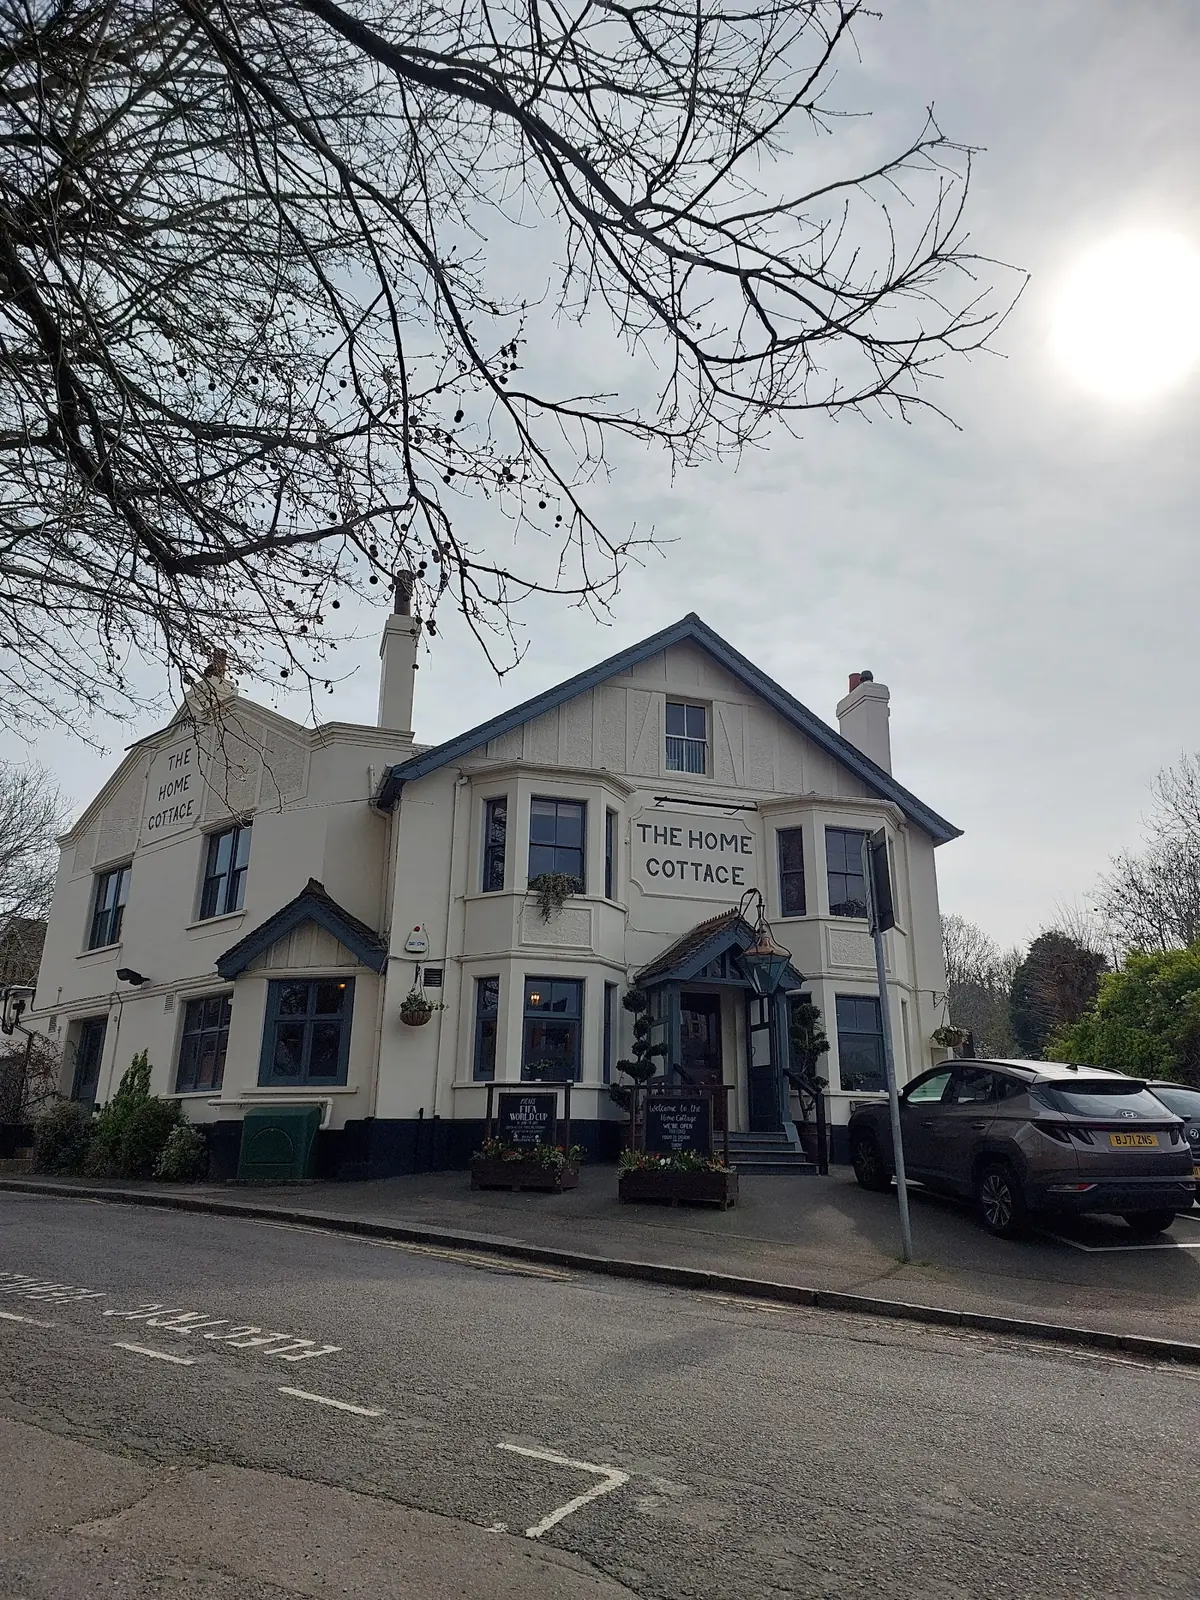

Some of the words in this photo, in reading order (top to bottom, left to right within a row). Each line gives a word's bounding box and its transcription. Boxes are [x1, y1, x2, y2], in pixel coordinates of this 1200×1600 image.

[168, 748, 192, 771] THE
[158, 774, 192, 801] HOME
[148, 799, 195, 830] COTTAGE
[636, 823, 682, 847] THE
[688, 829, 753, 855] HOME
[645, 857, 745, 886] COTTAGE
[509, 1112, 535, 1121] WORLD
[535, 1112, 548, 1121] CUP
[519, 1105, 537, 1114] FIFA
[649, 1103, 677, 1113] Welcome
[680, 1104, 688, 1112] to
[690, 1104, 701, 1113] the
[660, 1113, 675, 1121] Home
[675, 1114, 697, 1123] Cottage
[1115, 1134, 1136, 1145] BJ71
[1137, 1134, 1153, 1145] ZNS
[0, 1271, 107, 1304] VEHICL
[102, 1303, 343, 1362] ELECTRIC
